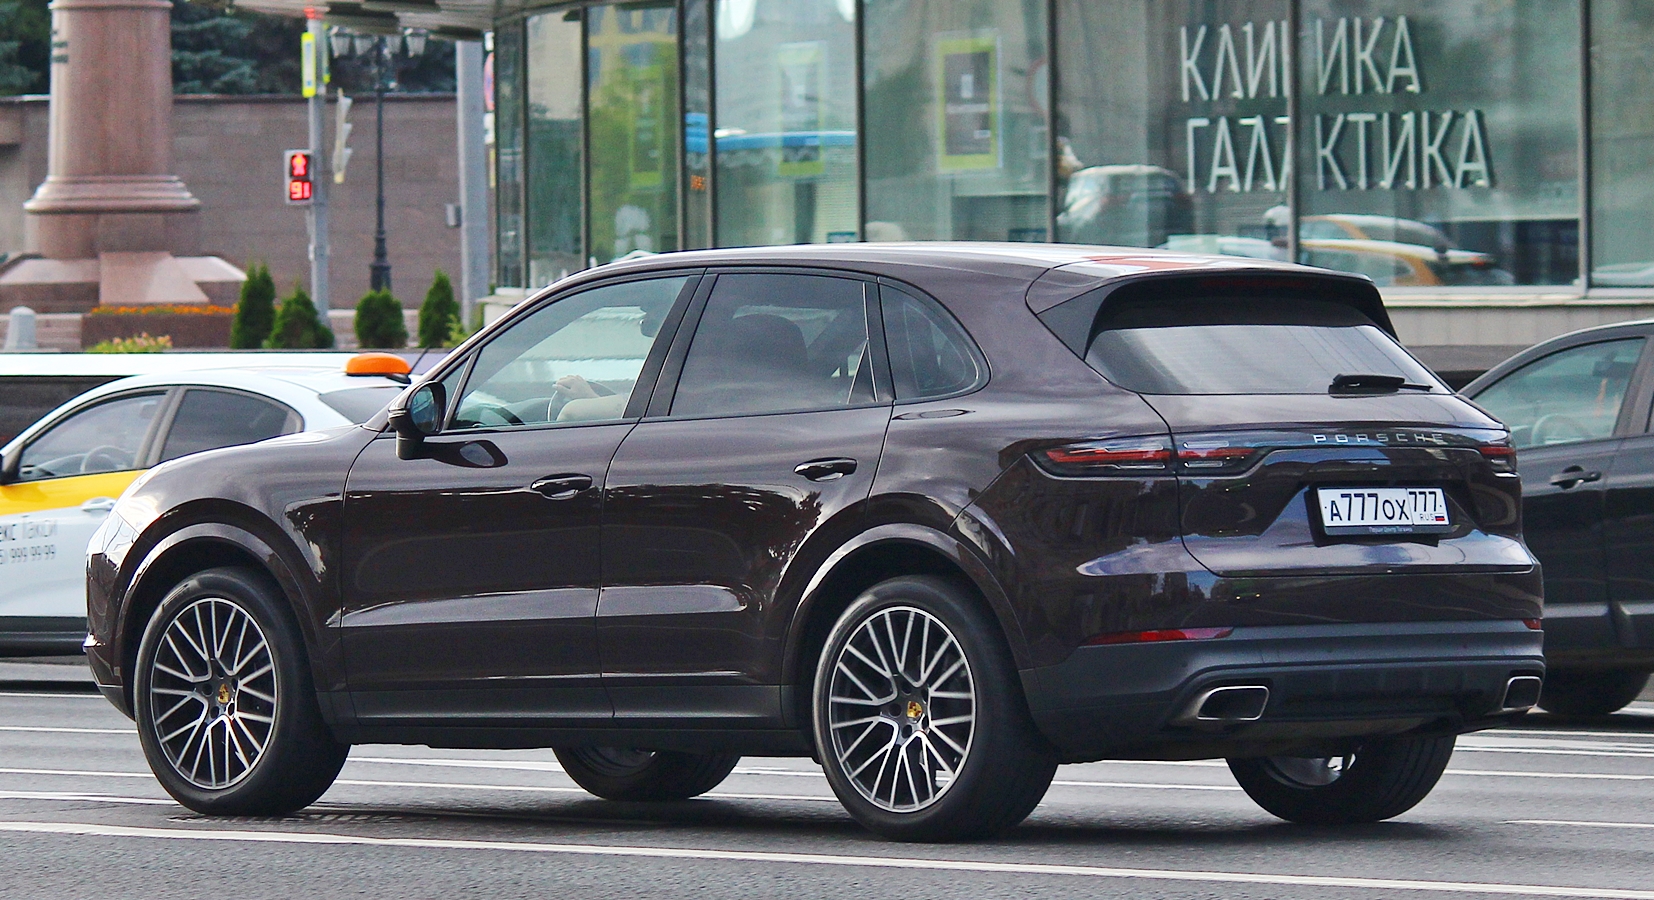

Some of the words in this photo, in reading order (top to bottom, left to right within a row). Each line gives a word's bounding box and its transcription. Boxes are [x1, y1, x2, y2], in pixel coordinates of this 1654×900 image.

[290, 181, 311, 199] 91
[1312, 433, 1443, 444] PORSCHE
[1408, 491, 1437, 512] 777
[1420, 513, 1435, 521] RUS
